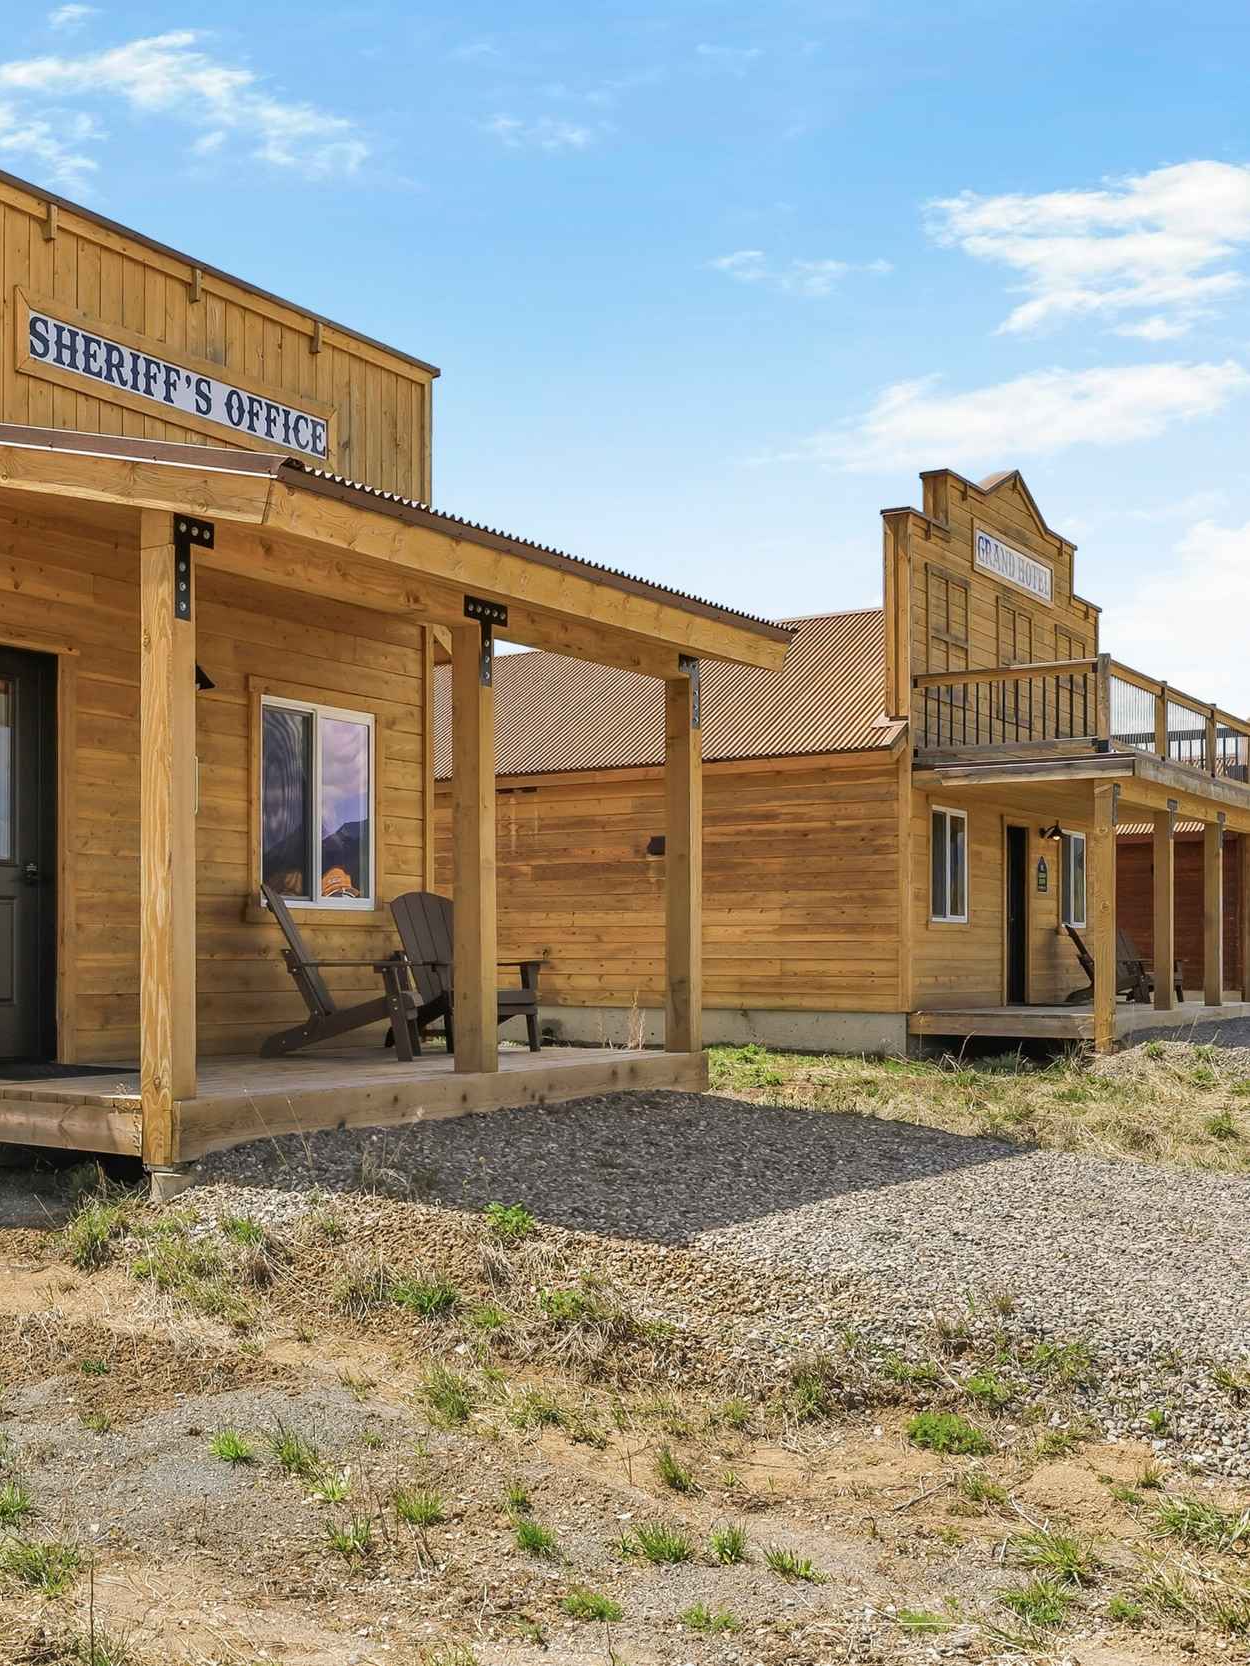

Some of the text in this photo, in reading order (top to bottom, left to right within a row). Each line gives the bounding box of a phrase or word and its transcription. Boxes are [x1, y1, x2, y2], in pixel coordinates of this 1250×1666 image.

[29, 316, 327, 456] SHERIFF'S OFFICE
[978, 535, 1048, 595] GRAND HOTEL
